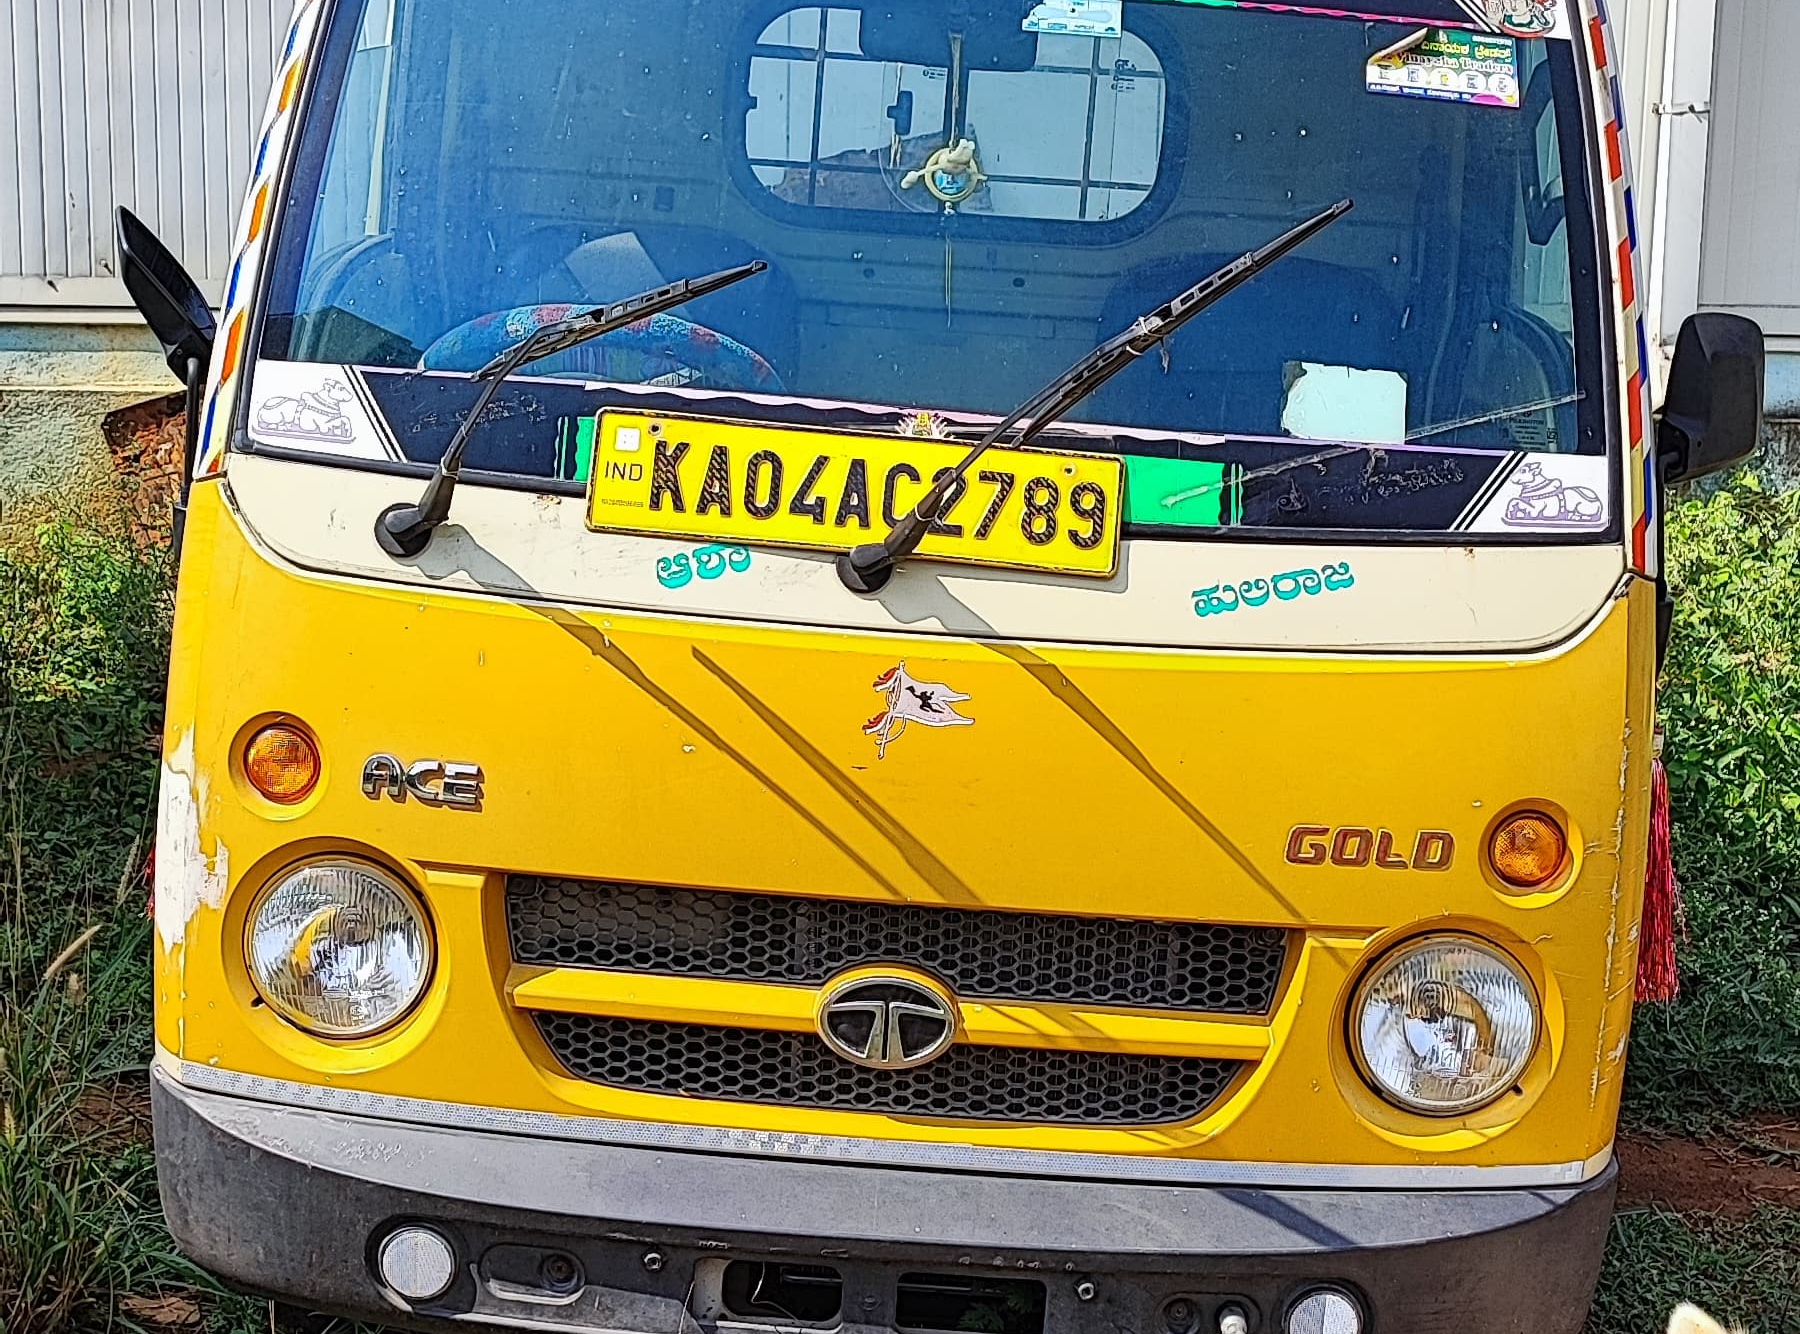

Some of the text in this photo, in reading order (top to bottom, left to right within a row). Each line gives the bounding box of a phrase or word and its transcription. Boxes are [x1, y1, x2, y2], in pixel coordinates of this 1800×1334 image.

[605, 460, 643, 481] IND
[648, 440, 1107, 550] KA04AC2789
[1191, 561, 1354, 618] ಹುಲಿರಾಜ
[361, 753, 484, 812] ACE
[1284, 824, 1456, 872] GOLD
